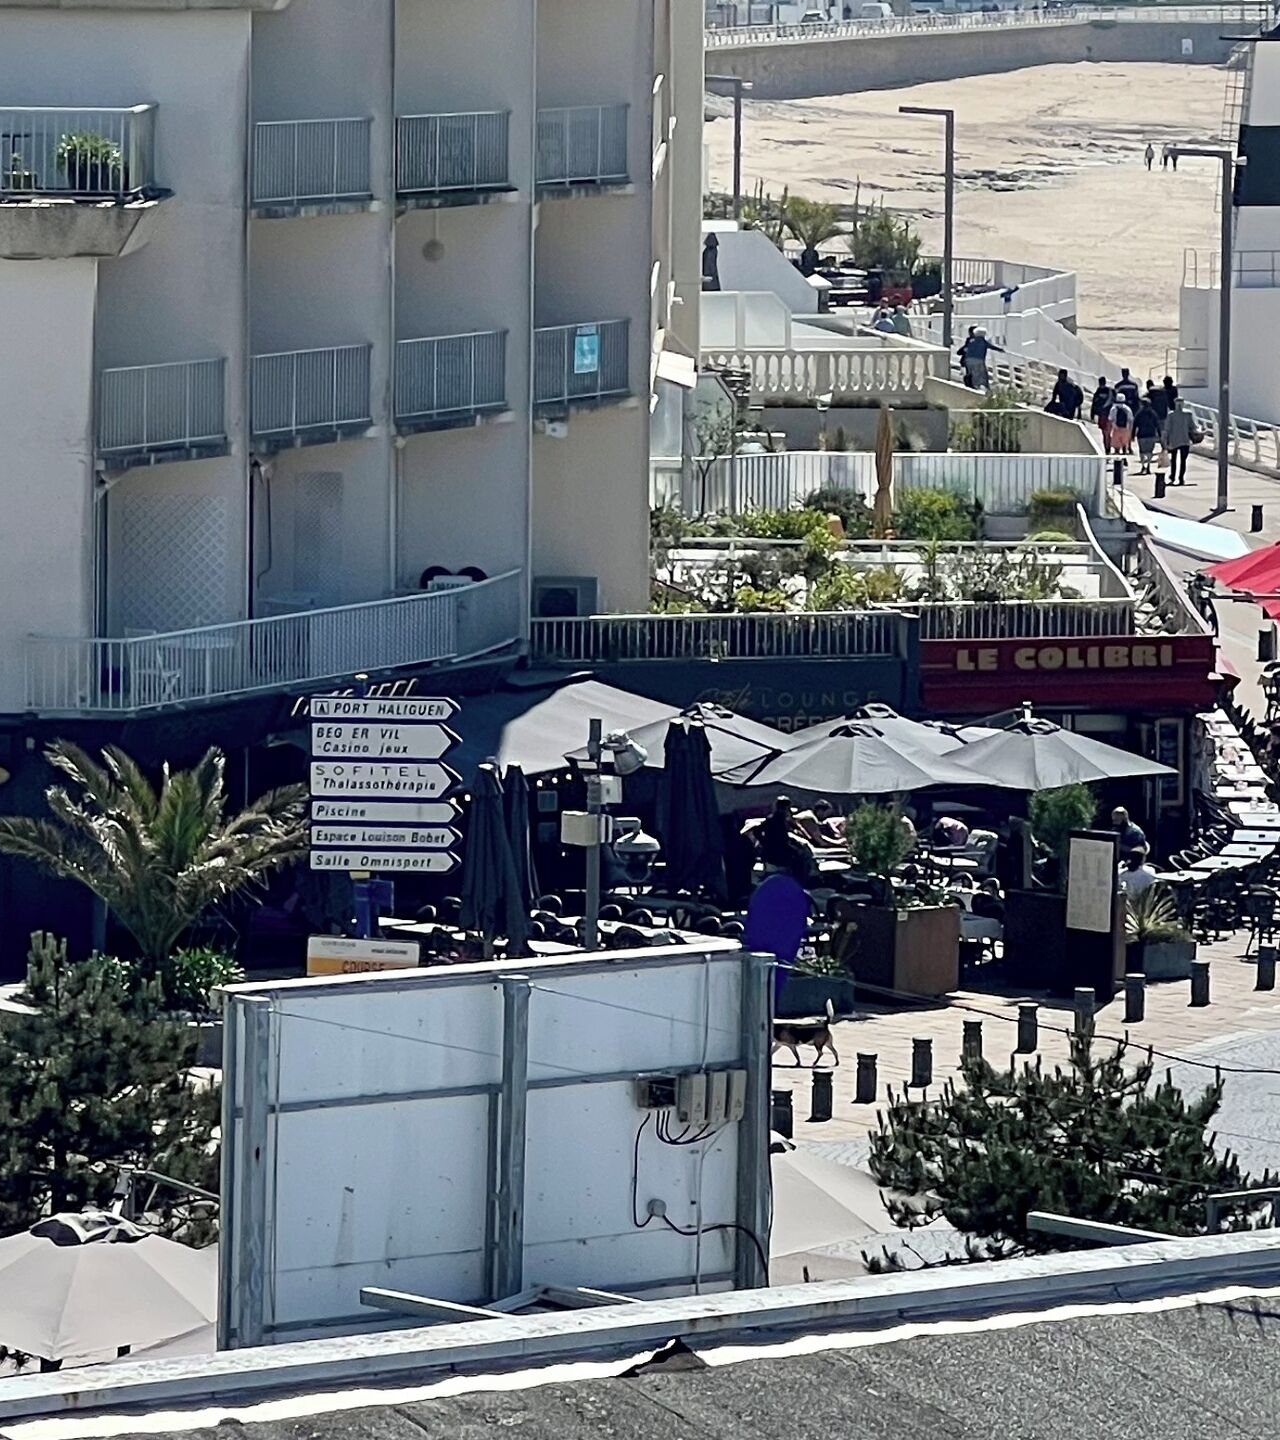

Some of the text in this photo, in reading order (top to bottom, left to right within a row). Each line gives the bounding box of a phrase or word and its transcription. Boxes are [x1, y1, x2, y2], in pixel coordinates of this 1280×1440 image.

[956, 645, 1173, 671] LE COLIBRI
[333, 702, 445, 716] PORT HALIGUEN
[317, 727, 400, 740] BEG ER VIL
[379, 743, 408, 756] jeux
[316, 766, 426, 776] SOFITEL
[317, 805, 366, 817] Piscine
[316, 831, 445, 843] Espace Louison Bobet
[316, 855, 431, 870] Salle Omnisport
